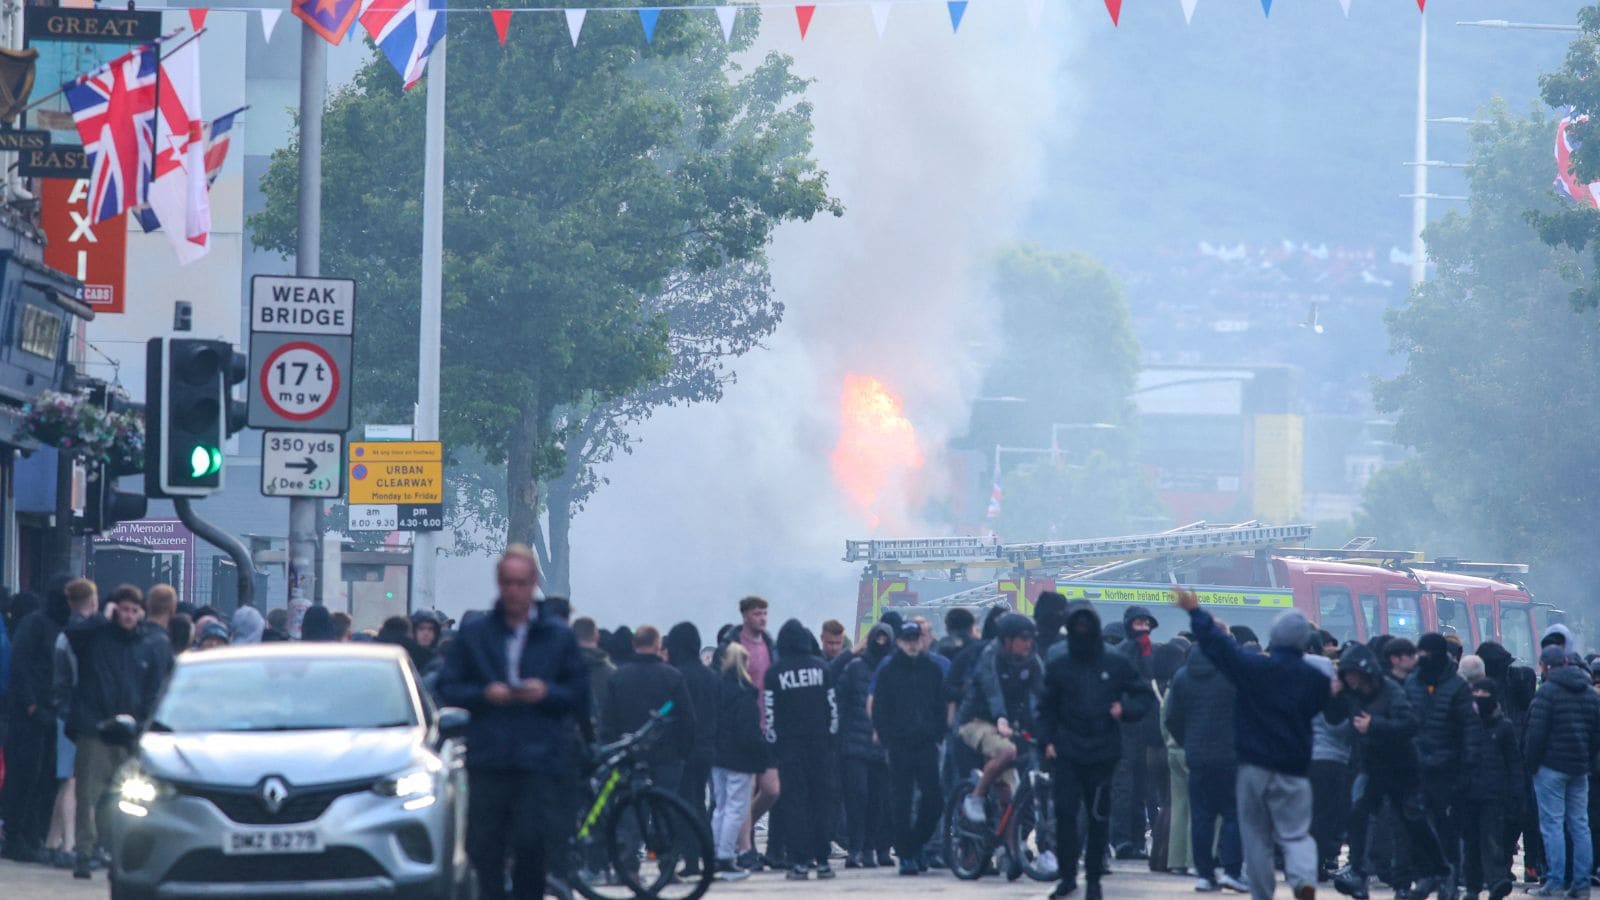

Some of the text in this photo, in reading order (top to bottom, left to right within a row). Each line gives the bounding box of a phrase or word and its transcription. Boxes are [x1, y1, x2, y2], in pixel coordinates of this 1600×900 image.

[47, 15, 139, 36] GREAT
[0, 133, 44, 149] NNESS
[30, 151, 91, 169] EAST
[67, 178, 98, 281] AXI
[84, 288, 110, 300] CABS
[272, 285, 336, 304] WEAK
[261, 306, 345, 326] BRIDGE
[271, 437, 335, 455] 350 yds
[386, 465, 424, 475] URBAN
[271, 477, 332, 492] (Dee St)
[376, 478, 434, 487] CLEARWAY
[371, 492, 402, 501] Monday
[414, 492, 438, 501] Friday
[366, 508, 380, 516] am
[412, 508, 428, 516] pm
[113, 523, 174, 534] ain Memorial
[143, 536, 187, 545] Nazarene
[1104, 590, 1135, 601] Northern
[1136, 590, 1160, 601] Ireland
[1212, 594, 1240, 605] Service
[778, 667, 823, 690] KLEIN
